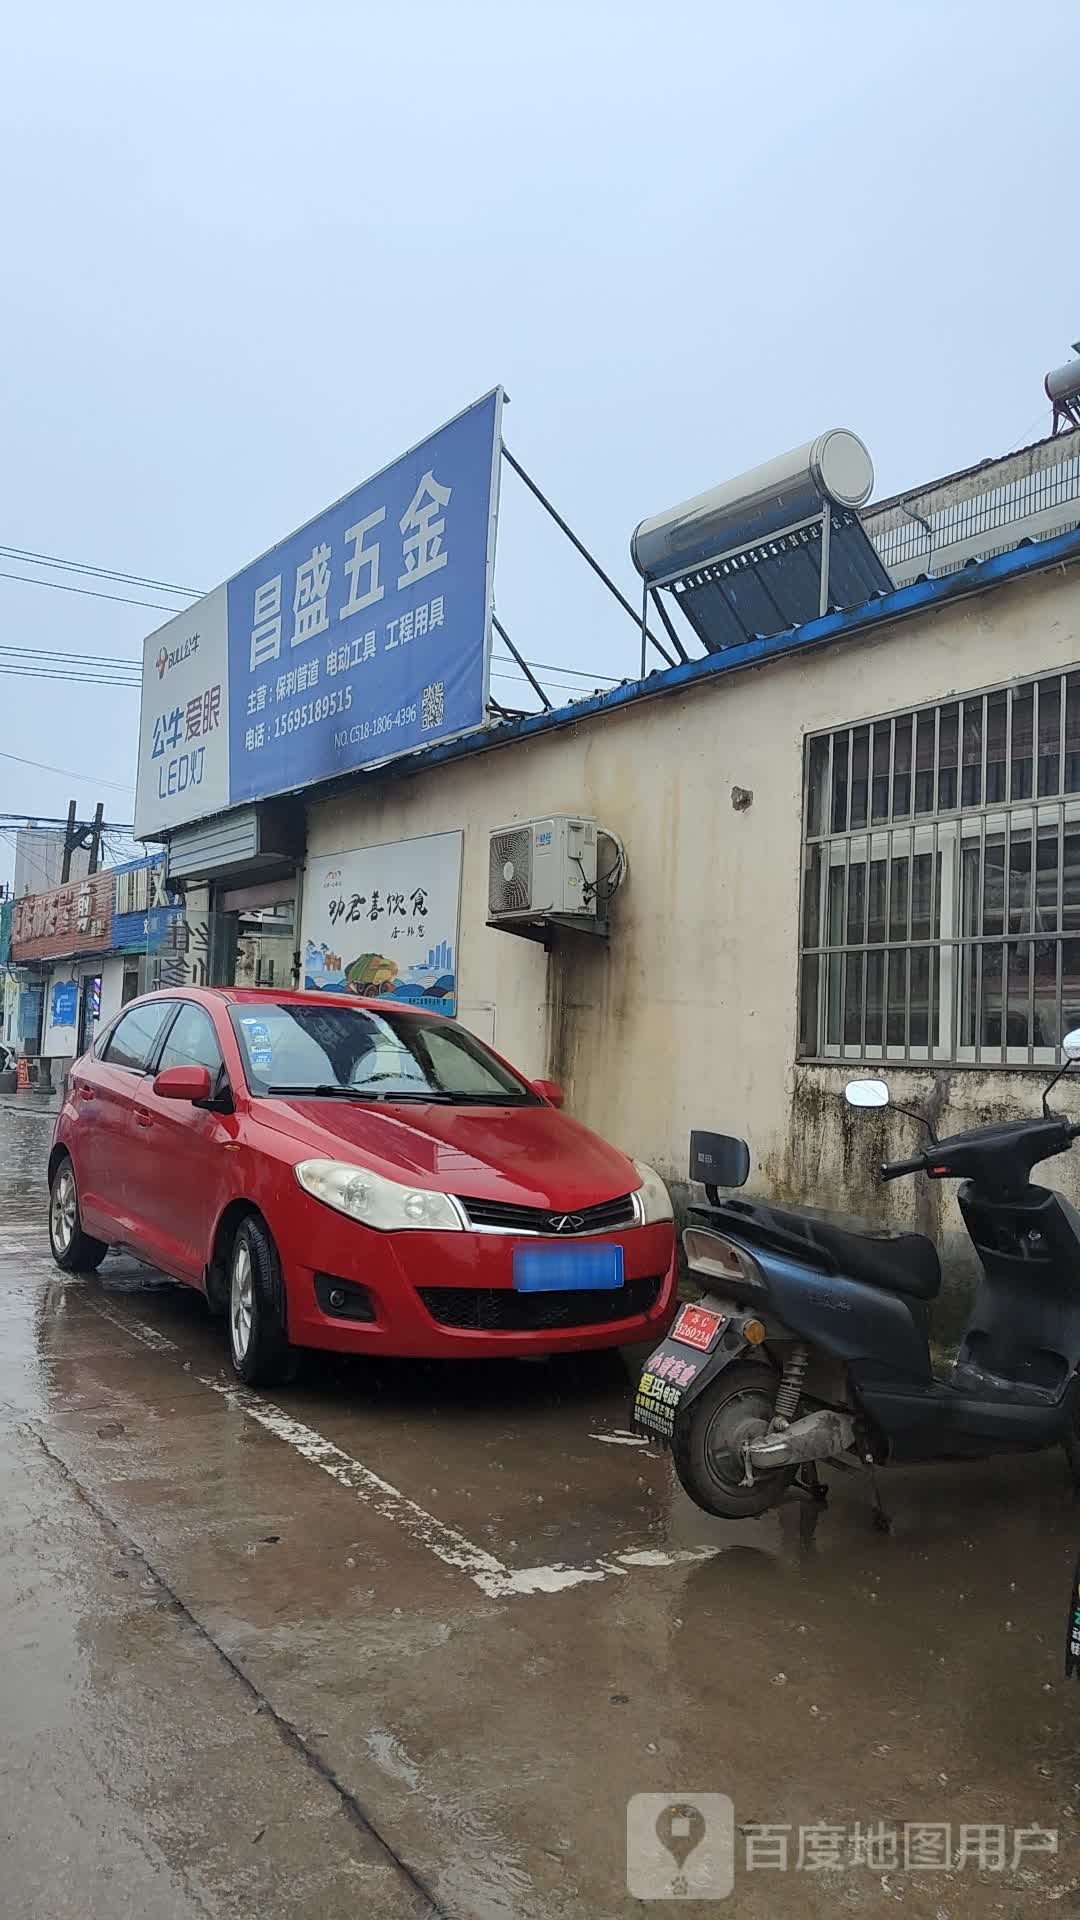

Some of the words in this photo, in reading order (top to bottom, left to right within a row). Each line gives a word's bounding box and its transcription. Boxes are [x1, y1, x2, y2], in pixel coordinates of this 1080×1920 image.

[249, 470, 453, 673] 昌盛五金
[326, 630, 377, 676] 电动工具
[385, 595, 445, 651] 工程用具
[151, 685, 221, 760] 公牛爱眼
